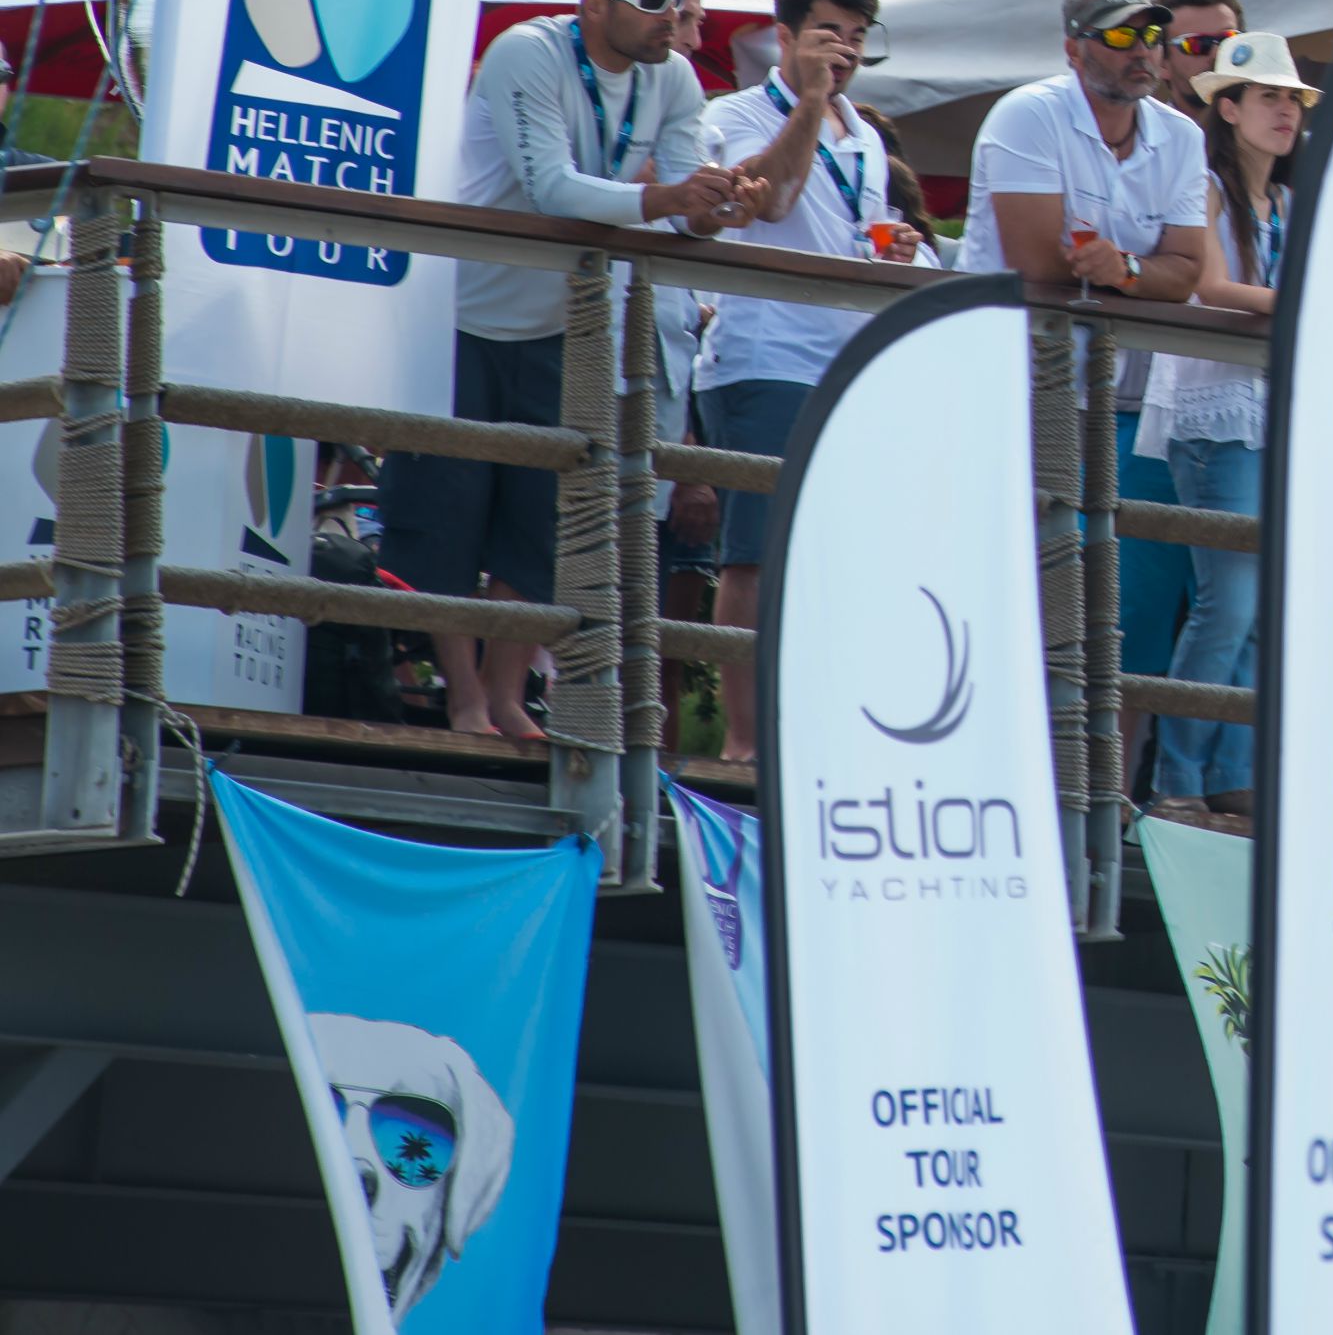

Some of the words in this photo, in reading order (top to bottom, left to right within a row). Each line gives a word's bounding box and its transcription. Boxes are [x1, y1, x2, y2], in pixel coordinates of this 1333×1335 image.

[230, 105, 396, 160] HELLENIC
[226, 144, 394, 194] MATCH
[816, 778, 1023, 861] istion
[820, 876, 1028, 901] YACHTING
[872, 1087, 1004, 1127] OFFICIAL
[905, 1149, 983, 1188] TOUR
[876, 1209, 1023, 1253] SPONSOR
